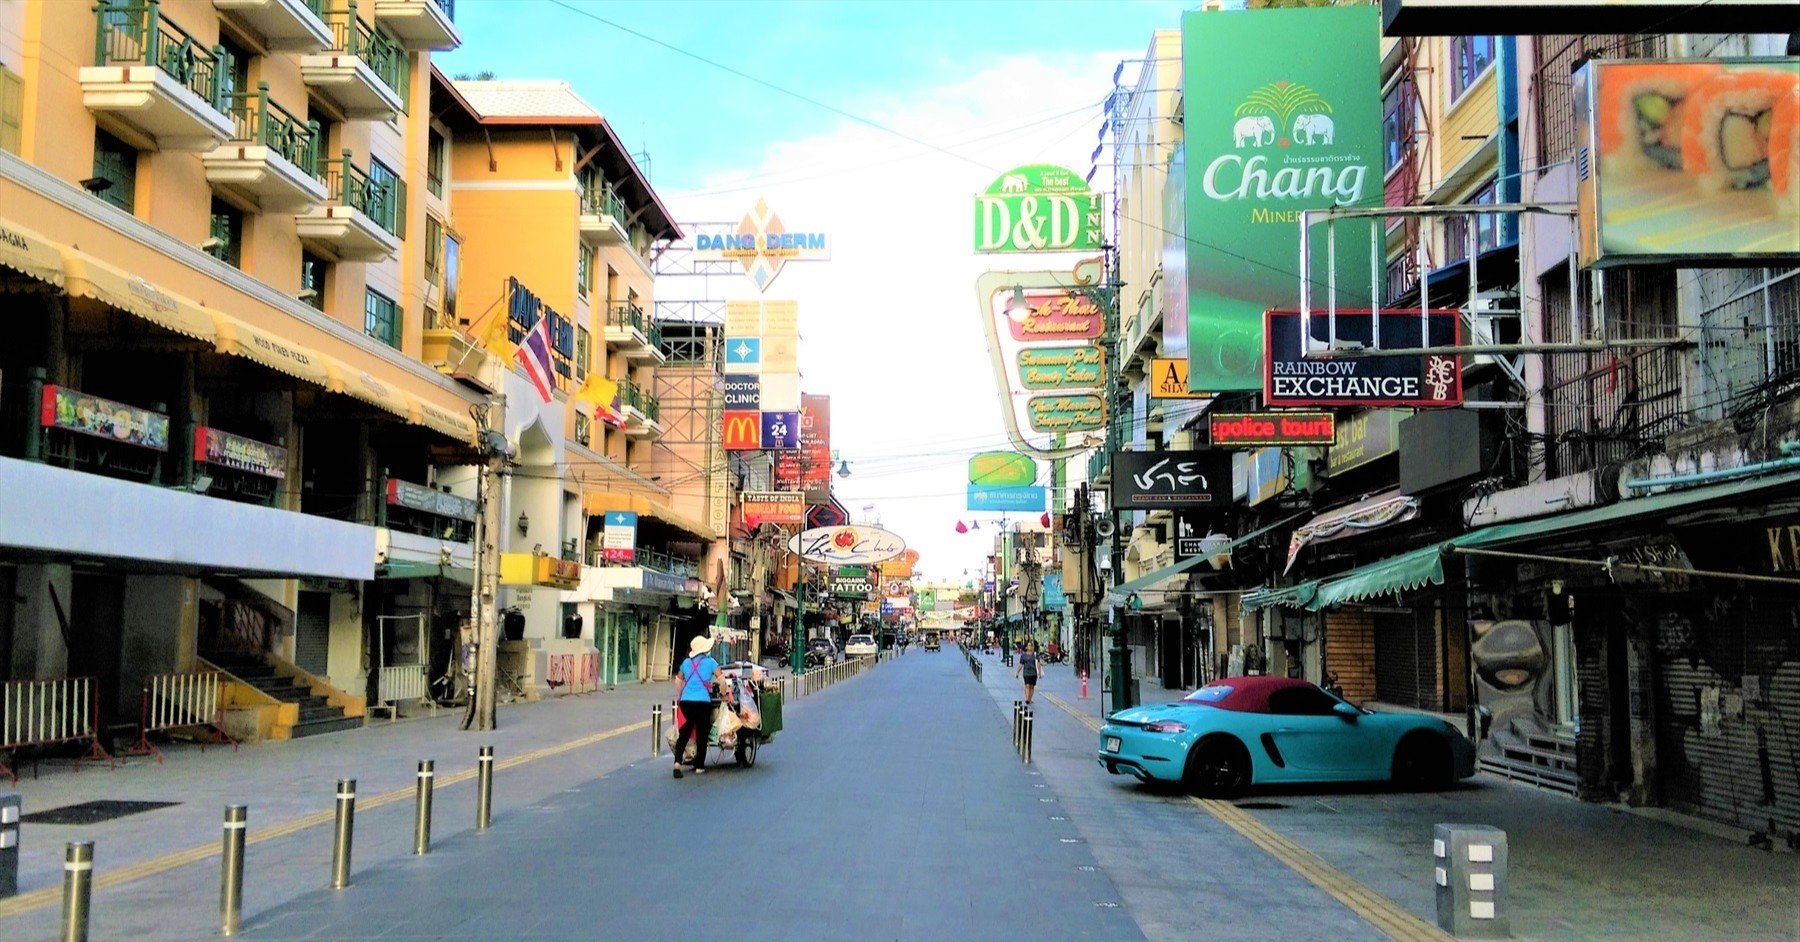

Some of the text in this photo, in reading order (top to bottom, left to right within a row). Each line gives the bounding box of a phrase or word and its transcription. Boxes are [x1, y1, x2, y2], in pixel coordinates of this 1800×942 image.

[1203, 154, 1367, 206] Chang
[1086, 194, 1102, 244] INN
[696, 233, 826, 250] DANG DERM
[1163, 362, 1188, 384] A
[1273, 361, 1358, 375] RAINBOW
[725, 383, 760, 391] DOCTOR
[1160, 384, 1188, 393] SILV
[1273, 377, 1420, 398] EXCHANGE
[724, 393, 760, 404] CLINIC
[771, 424, 787, 436] 24
[829, 583, 873, 592] TATTOO
